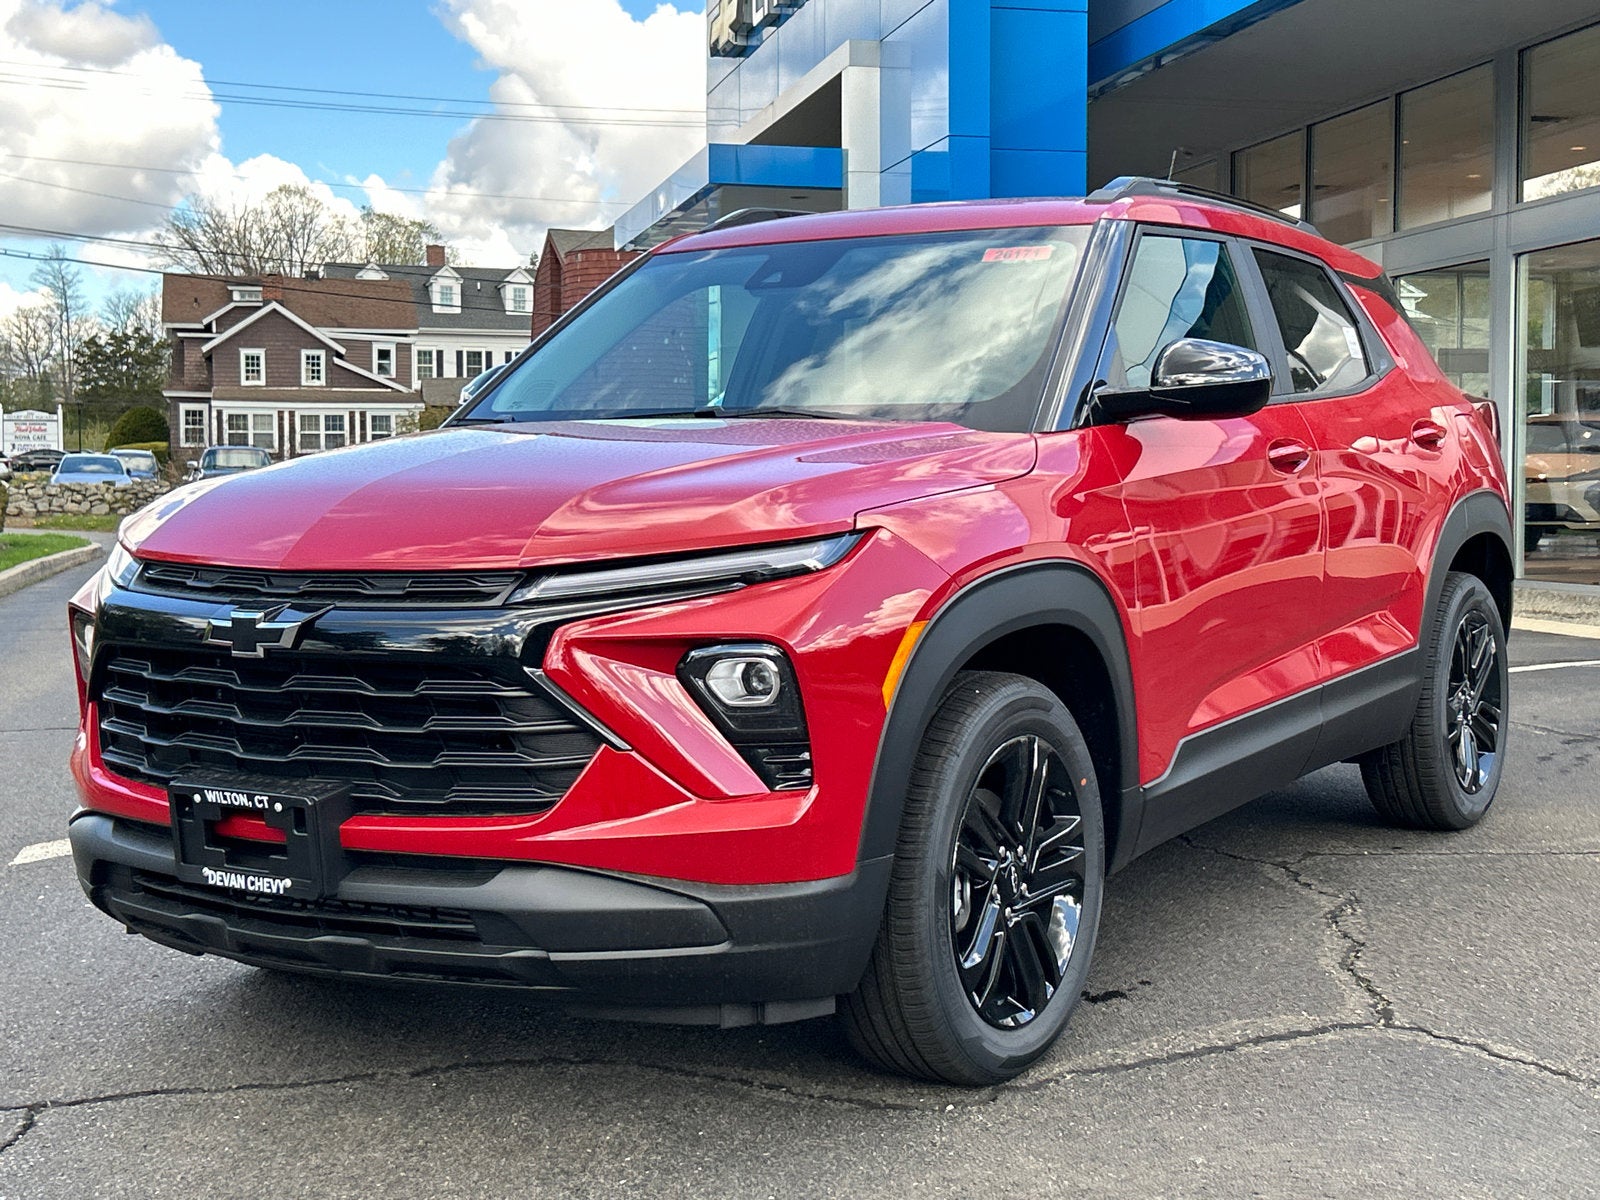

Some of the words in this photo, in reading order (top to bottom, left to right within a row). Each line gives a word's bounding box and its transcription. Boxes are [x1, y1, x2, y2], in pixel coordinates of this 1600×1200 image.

[204, 790, 253, 808] WILTON,
[254, 796, 269, 809] CT
[208, 870, 246, 889] DEVAN
[247, 876, 285, 894] CHEVY
